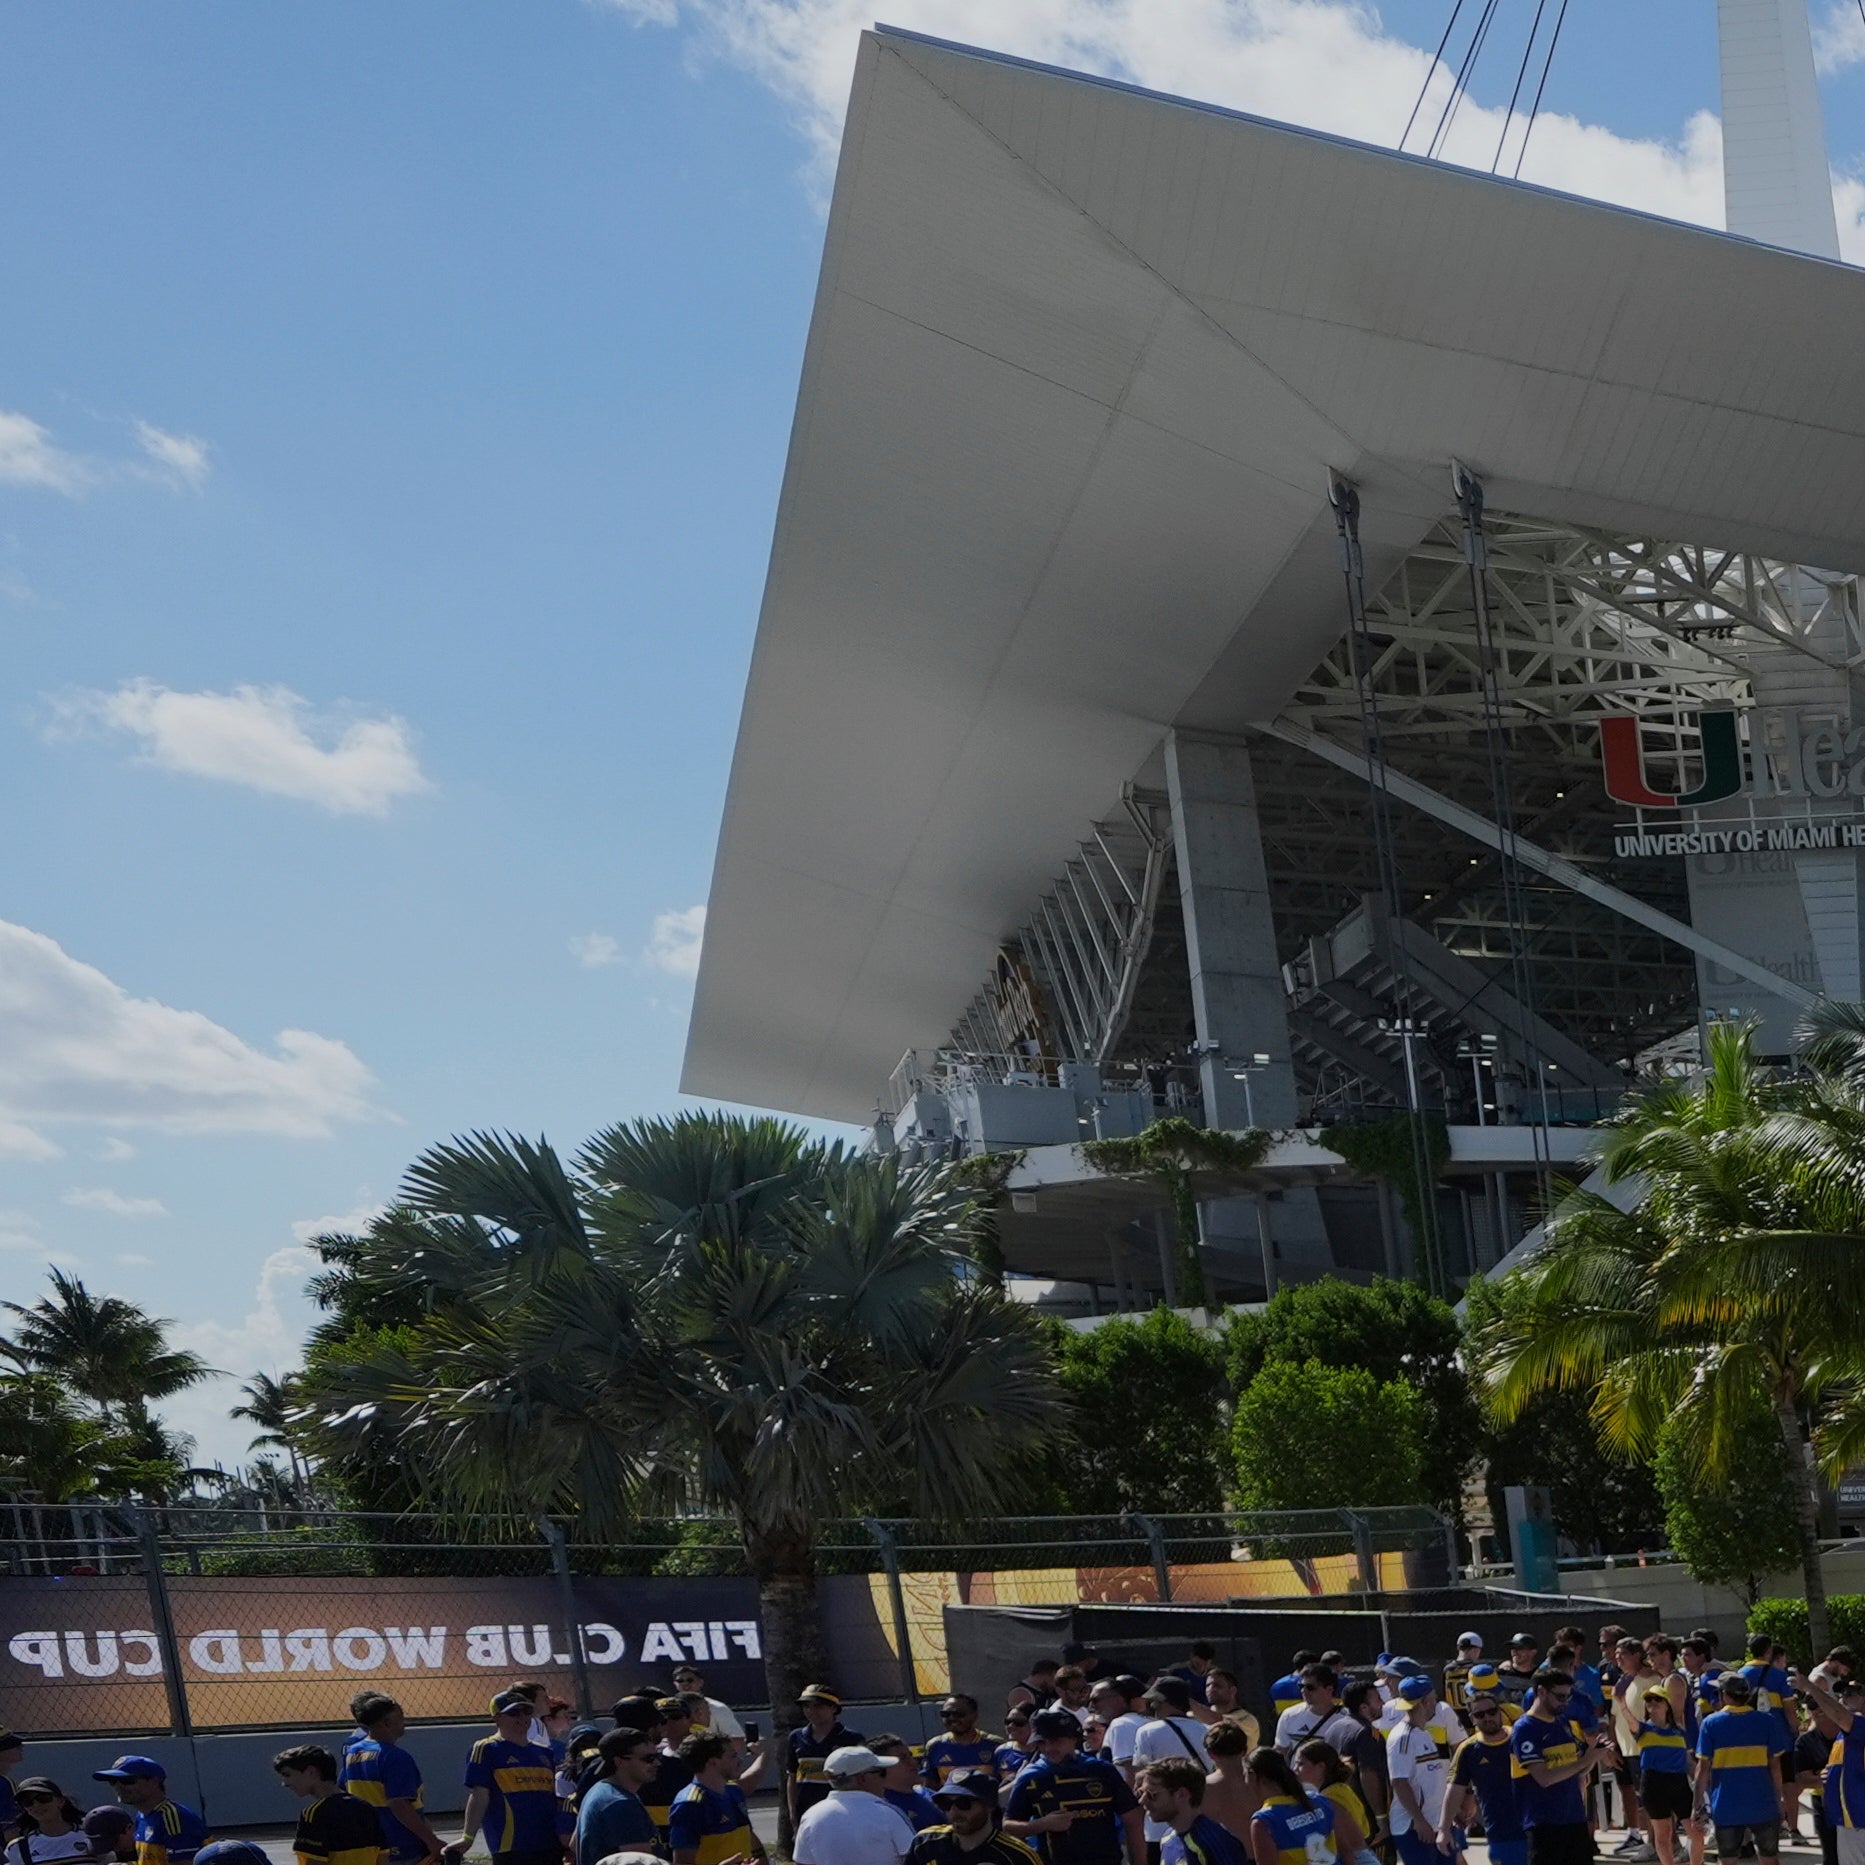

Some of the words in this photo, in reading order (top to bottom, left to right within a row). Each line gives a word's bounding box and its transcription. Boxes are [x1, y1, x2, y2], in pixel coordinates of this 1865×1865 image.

[1614, 827, 1736, 858] UNIVERSITY
[1736, 829, 1764, 852] OF
[1767, 827, 1838, 852] MIAMI
